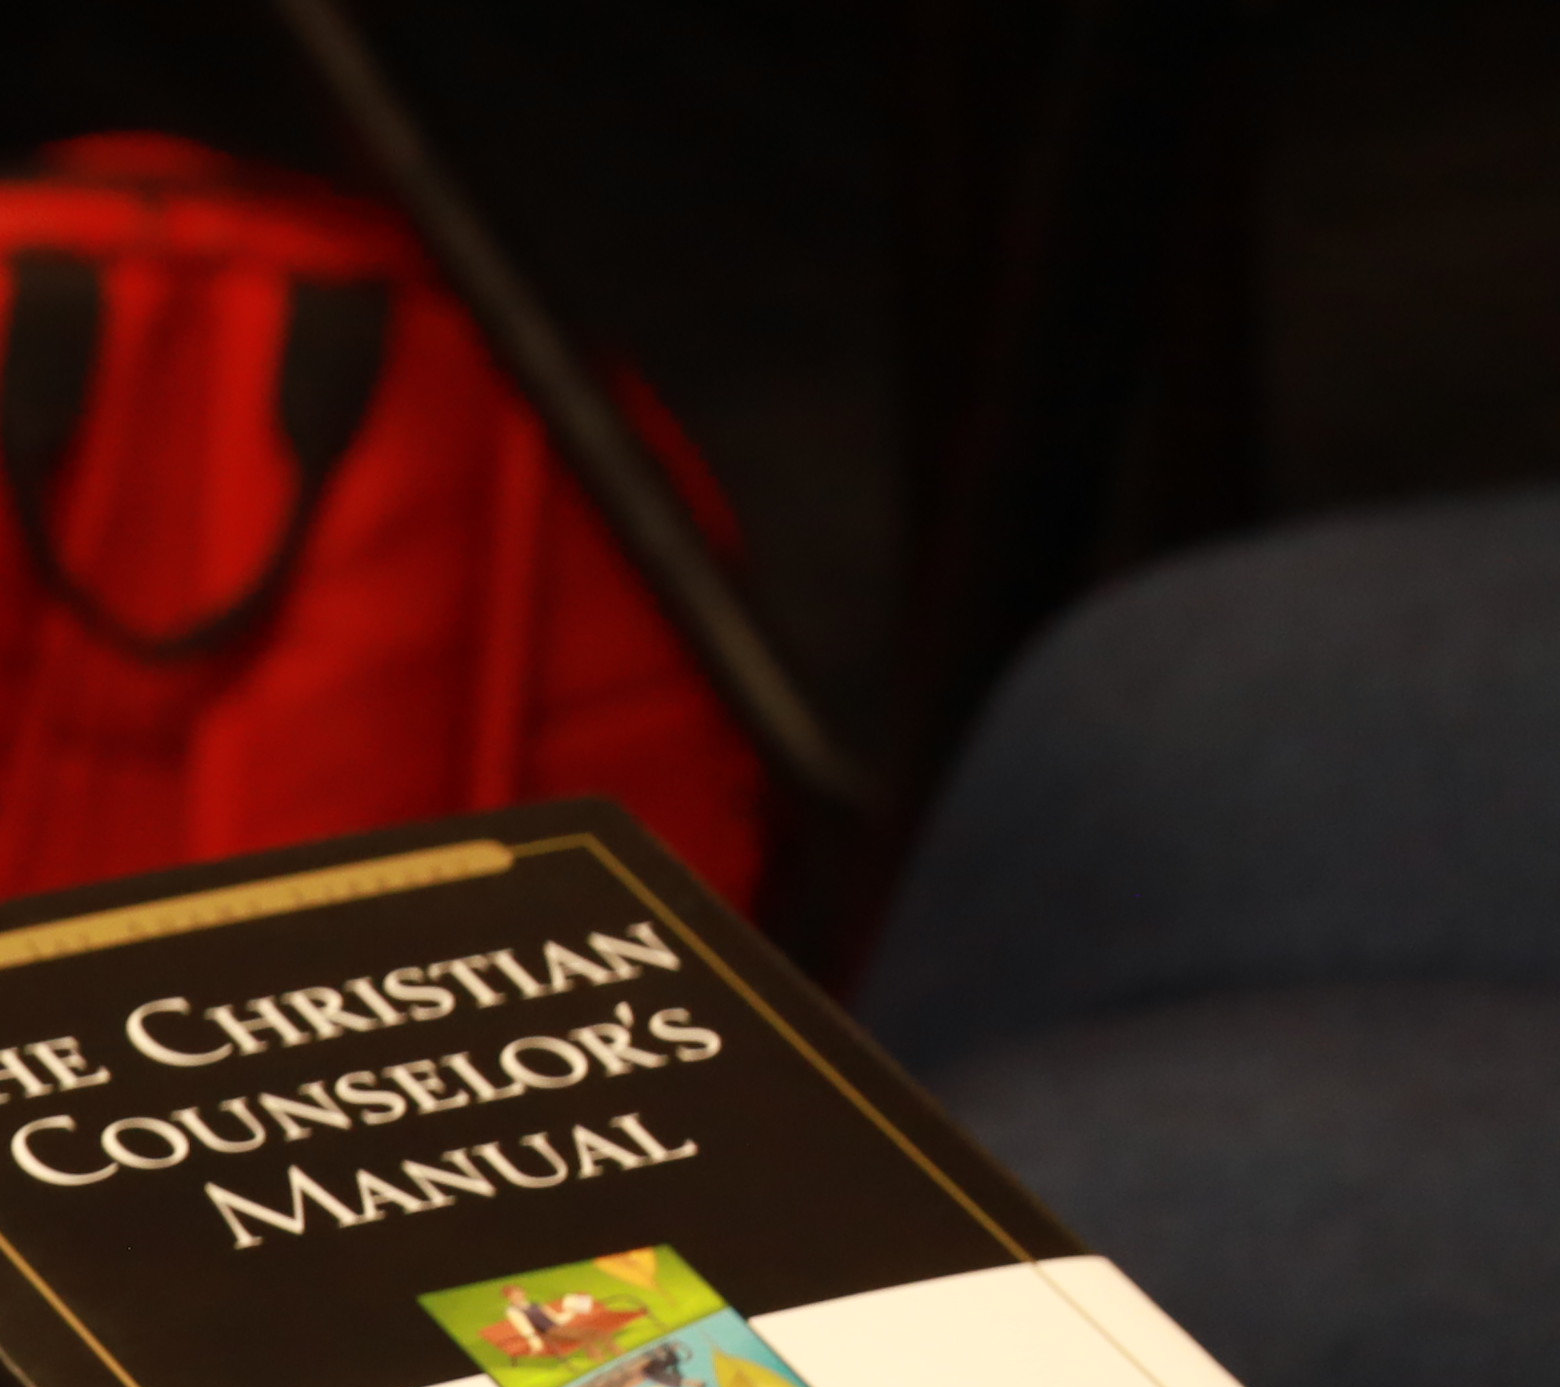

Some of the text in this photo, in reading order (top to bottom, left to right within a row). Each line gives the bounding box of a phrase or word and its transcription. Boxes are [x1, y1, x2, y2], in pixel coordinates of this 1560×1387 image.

[126, 921, 681, 1066] CHRISTIAN
[11, 1001, 722, 1187] COUNSELOR'S
[204, 1112, 698, 1249] MANUAL
